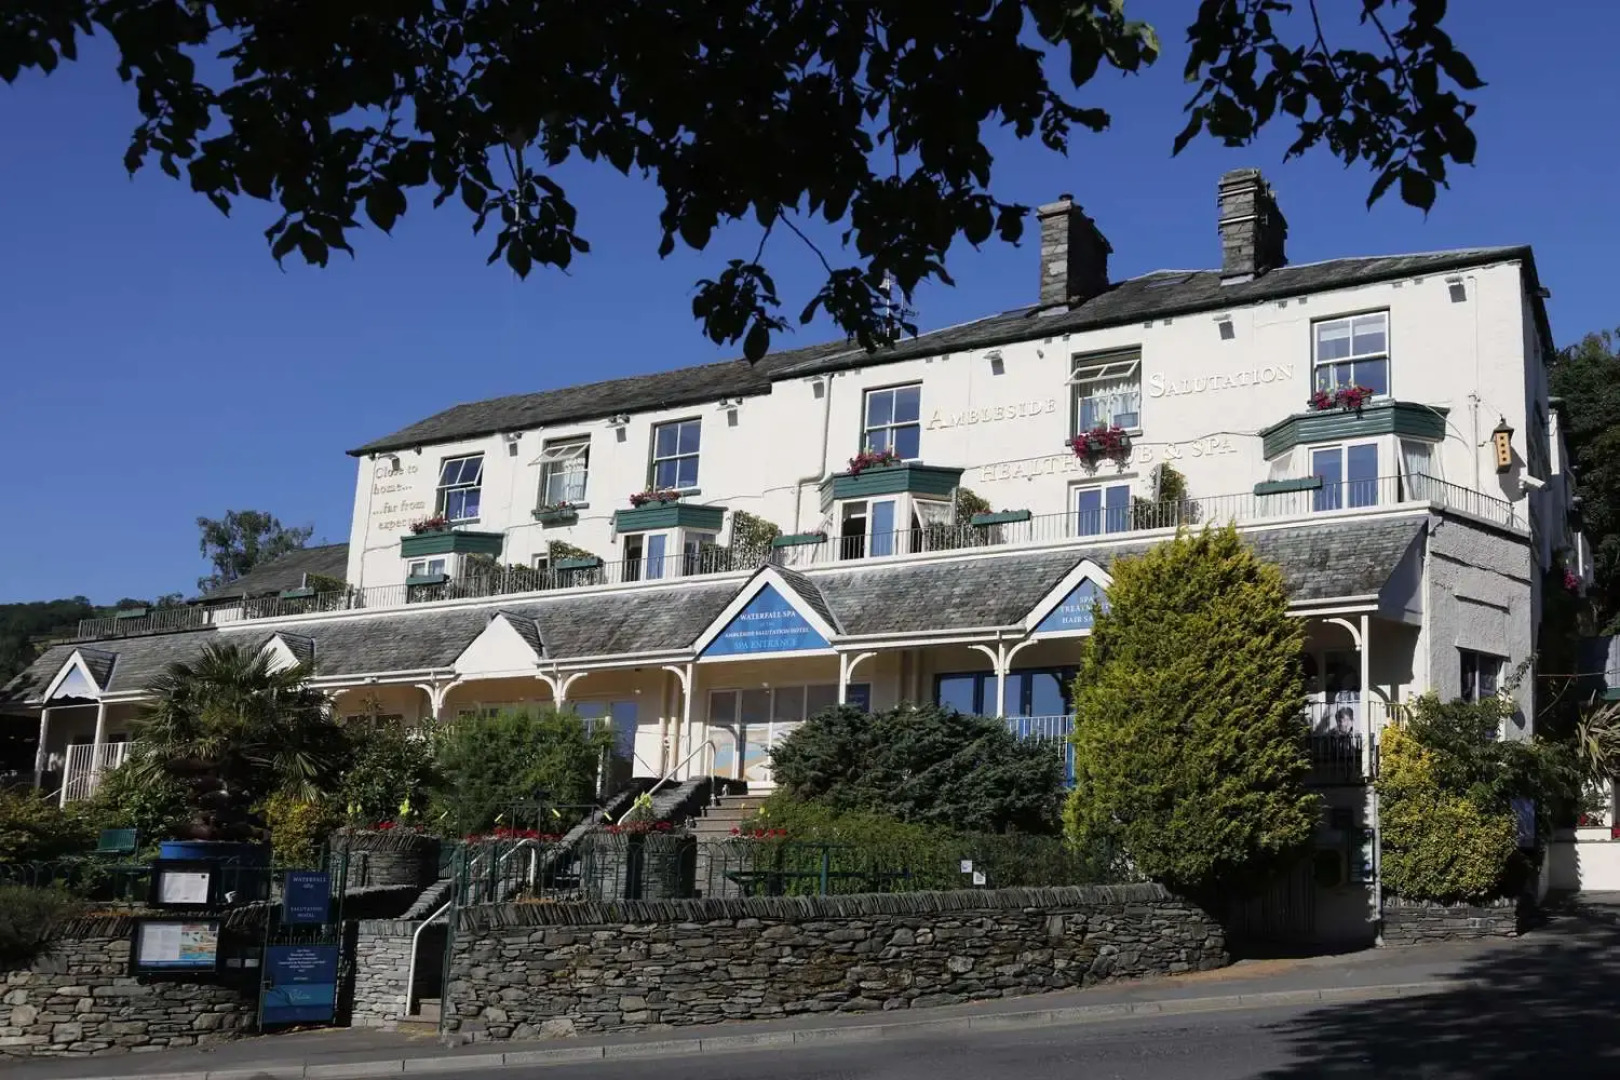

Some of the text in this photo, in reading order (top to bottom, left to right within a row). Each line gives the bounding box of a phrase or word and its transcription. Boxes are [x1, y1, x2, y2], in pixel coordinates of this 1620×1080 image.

[925, 363, 1294, 431] AMBLESIDE SALUTATION
[980, 454, 1080, 484] HEALTH
[1162, 443, 1184, 461] &
[1191, 436, 1239, 459] SPA
[408, 464, 418, 474] to
[400, 499, 425, 512] from
[740, 610, 796, 621] WATERFALL SPA
[1062, 616, 1082, 624] HAIR
